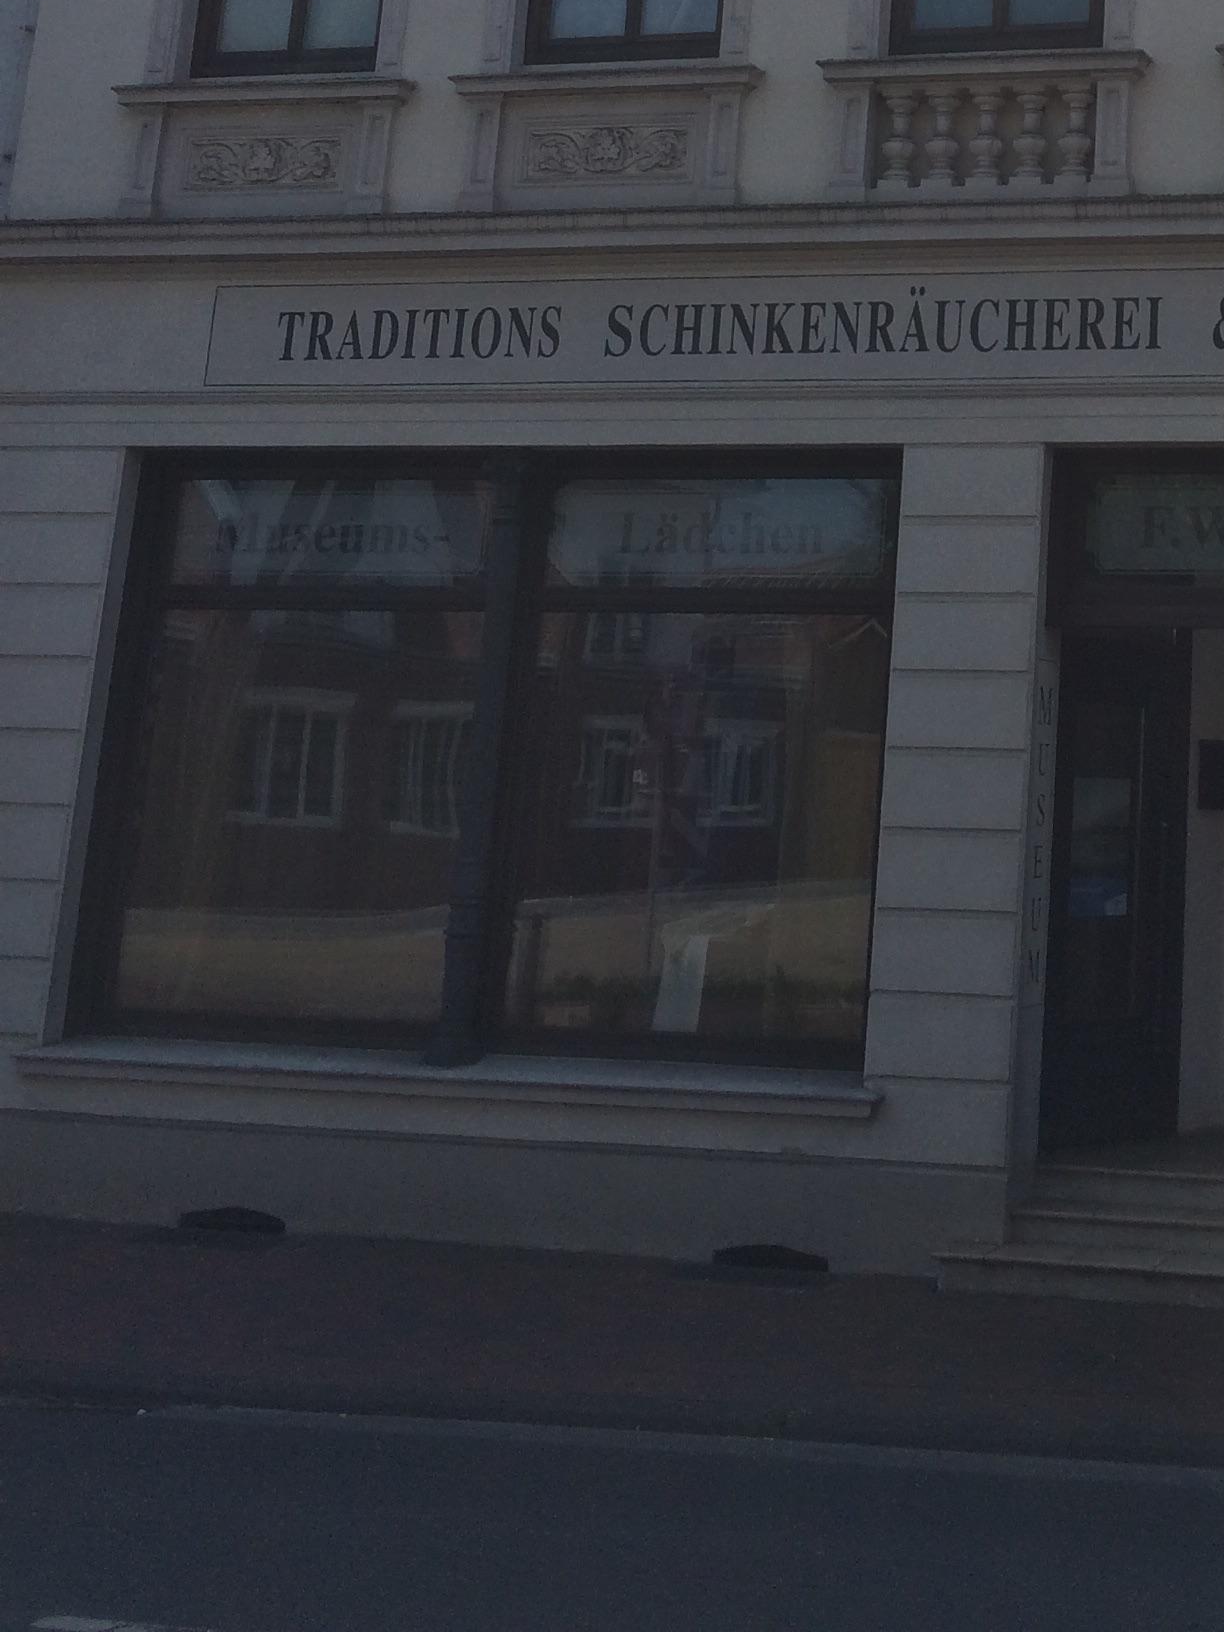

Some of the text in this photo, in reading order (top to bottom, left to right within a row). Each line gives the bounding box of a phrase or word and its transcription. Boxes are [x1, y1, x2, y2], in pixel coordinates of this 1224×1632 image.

[278, 306, 562, 361] TRADITIONS
[604, 285, 1163, 357] SCHINKENRÄUCHEREI
[620, 512, 826, 557] Lädchen
[1026, 684, 1055, 986] MUSEUM
